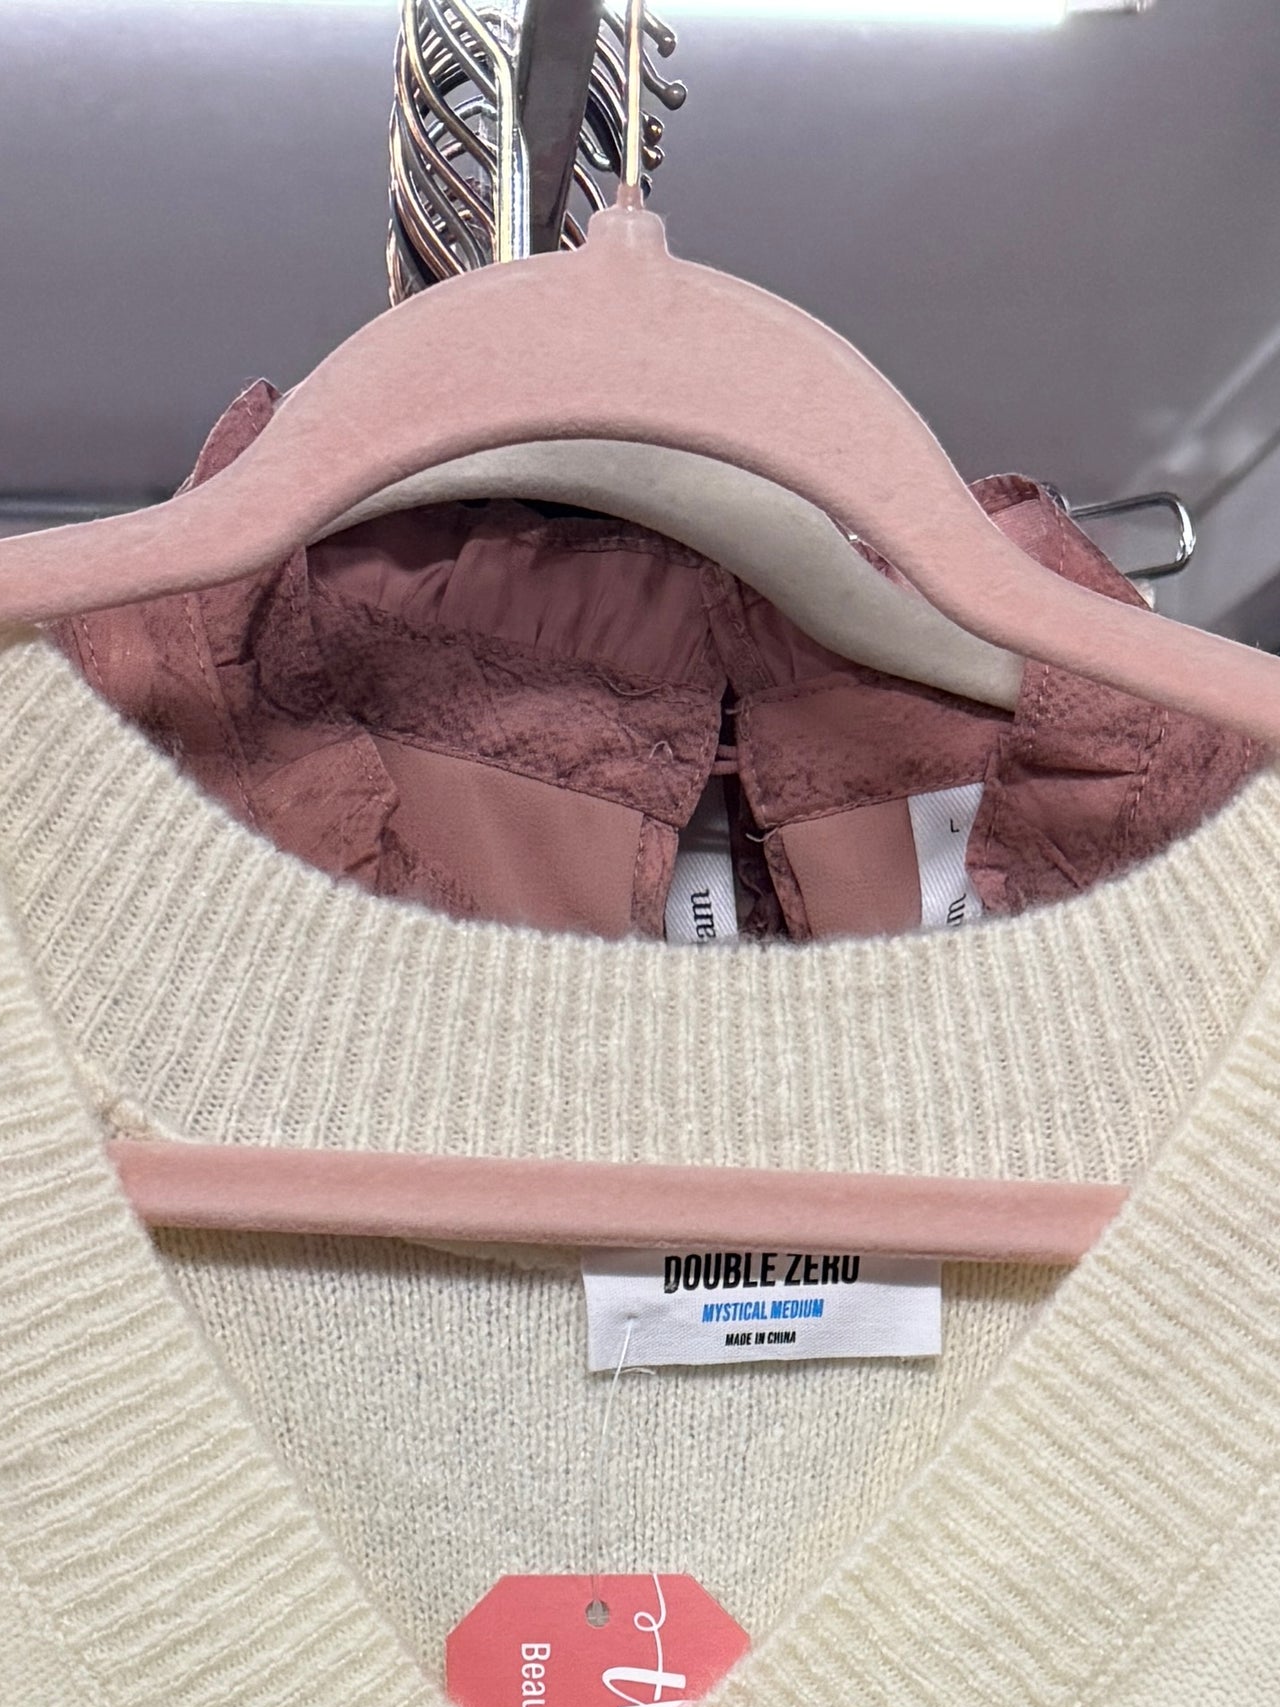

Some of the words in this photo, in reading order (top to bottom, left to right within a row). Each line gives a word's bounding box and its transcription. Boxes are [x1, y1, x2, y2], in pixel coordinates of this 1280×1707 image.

[950, 818, 960, 833] L
[663, 1252, 778, 1294] DOUBLE
[784, 1253, 861, 1286] ZERO
[701, 1300, 768, 1323] MYSTICAL
[770, 1298, 825, 1320] MEDIUM
[724, 1332, 753, 1347] MADE
[754, 1331, 766, 1345] IN
[767, 1330, 797, 1345] CHINA
